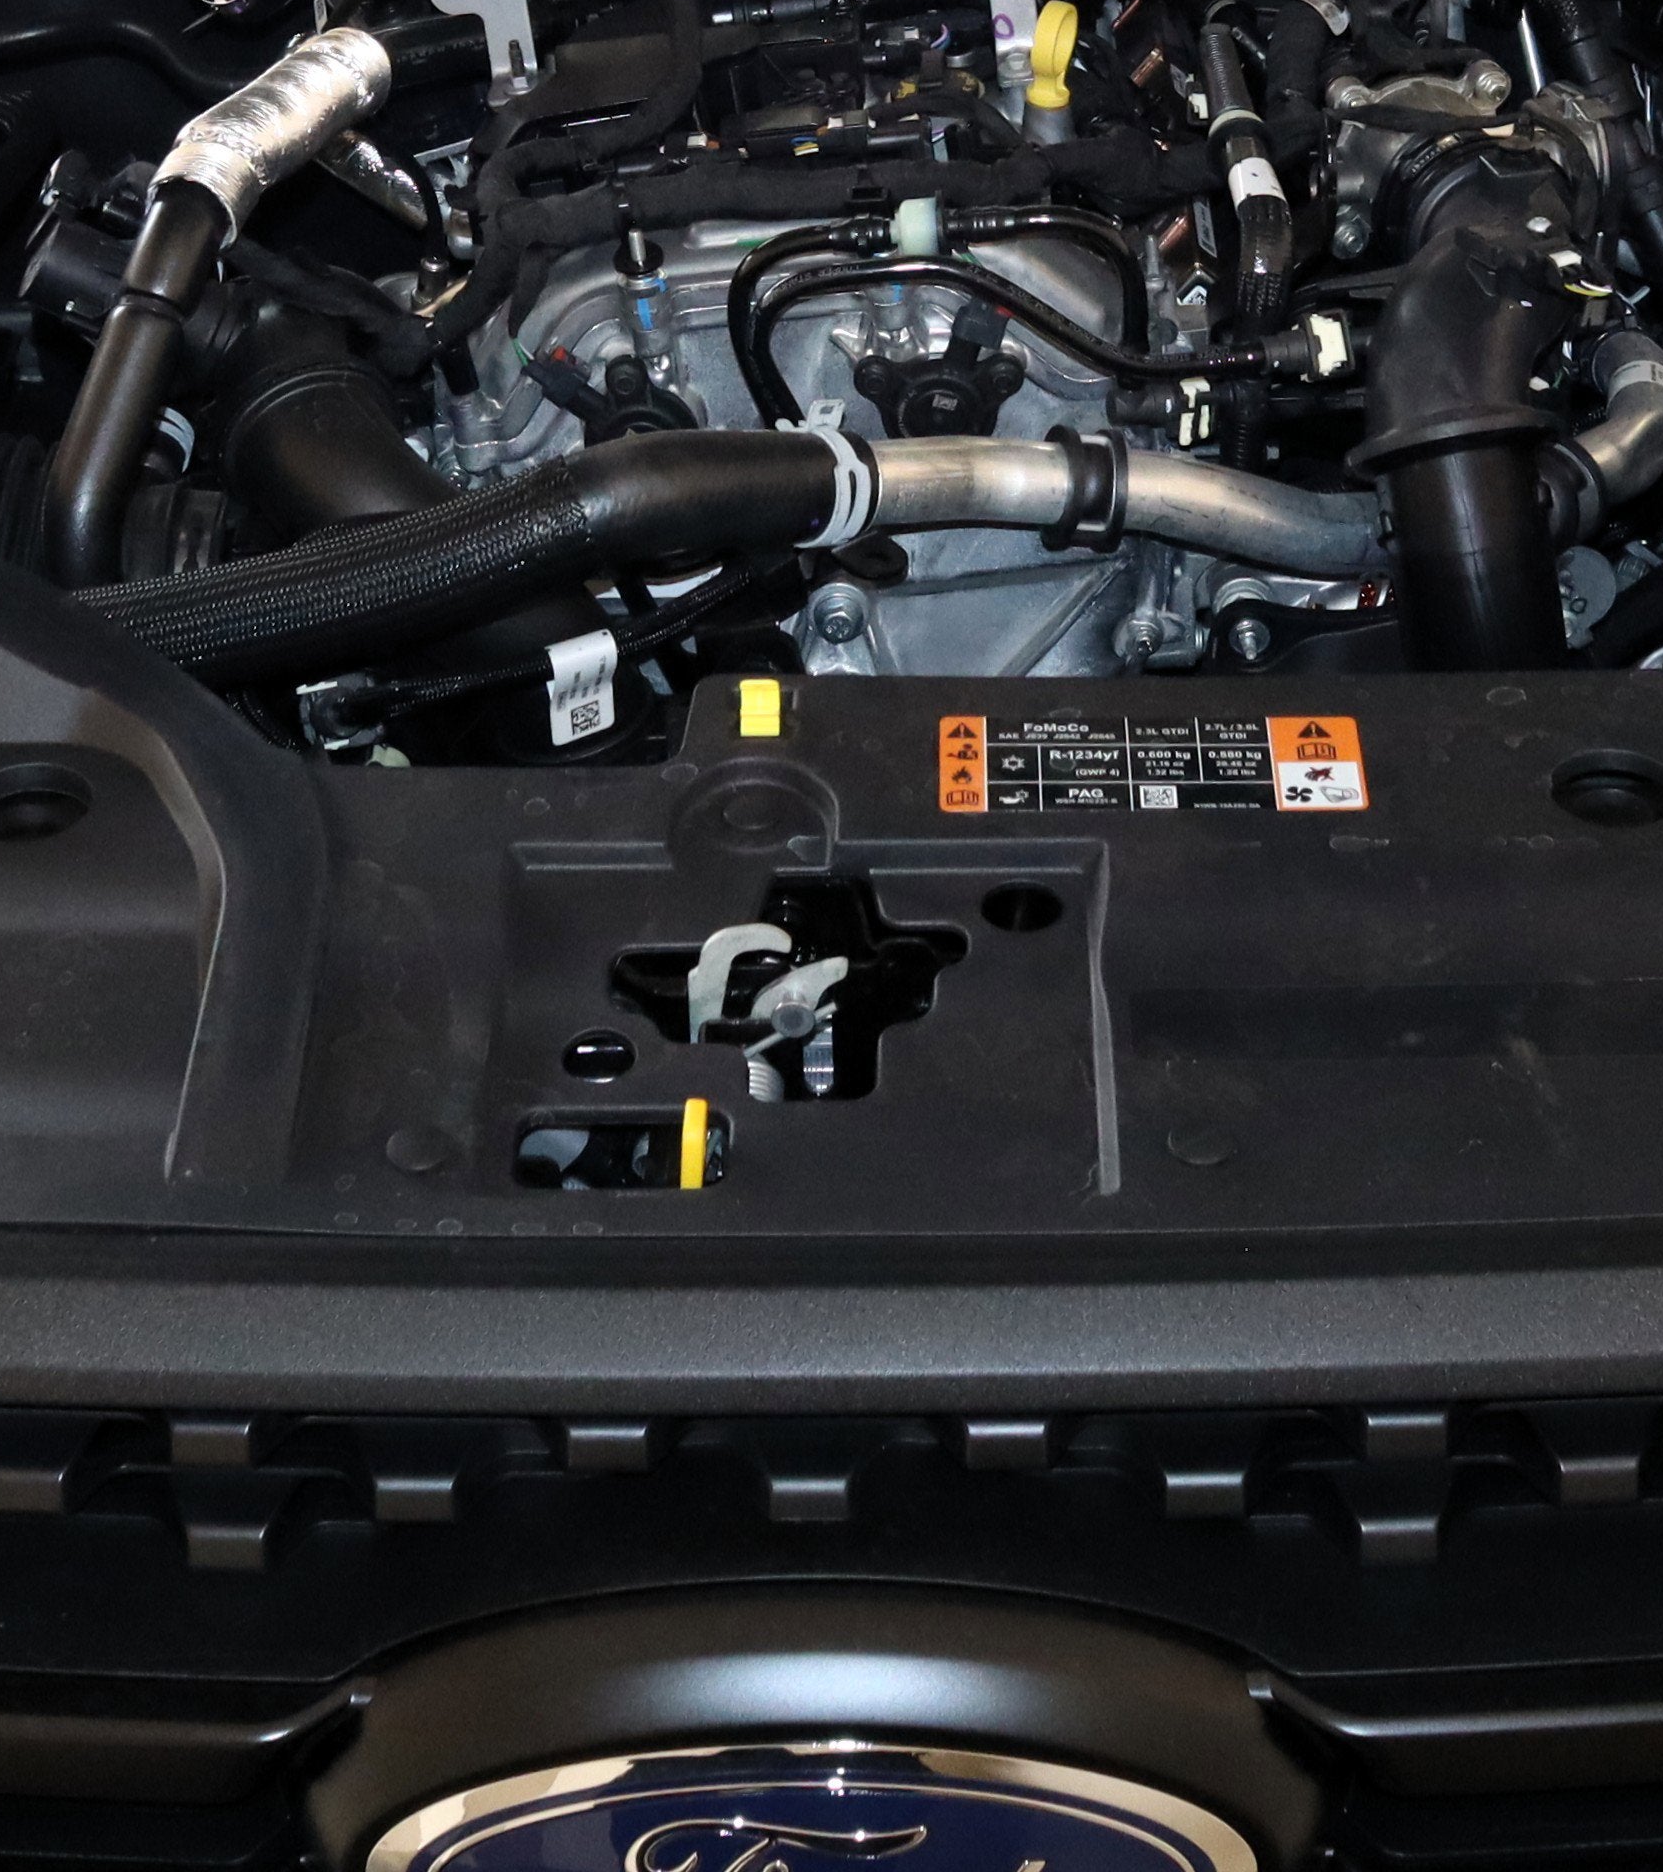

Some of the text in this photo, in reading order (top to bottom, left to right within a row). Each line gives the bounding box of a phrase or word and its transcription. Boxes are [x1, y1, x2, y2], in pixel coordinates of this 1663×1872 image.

[1023, 722, 1089, 733] FoMoCo
[1135, 727, 1159, 735] 2.3L
[1049, 749, 1119, 762] R-1234yf
[1137, 750, 1191, 760] 0.600 kg
[1246, 750, 1262, 760] kg
[1075, 768, 1120, 777] (GWP 4)
[1068, 788, 1104, 798] PAG
